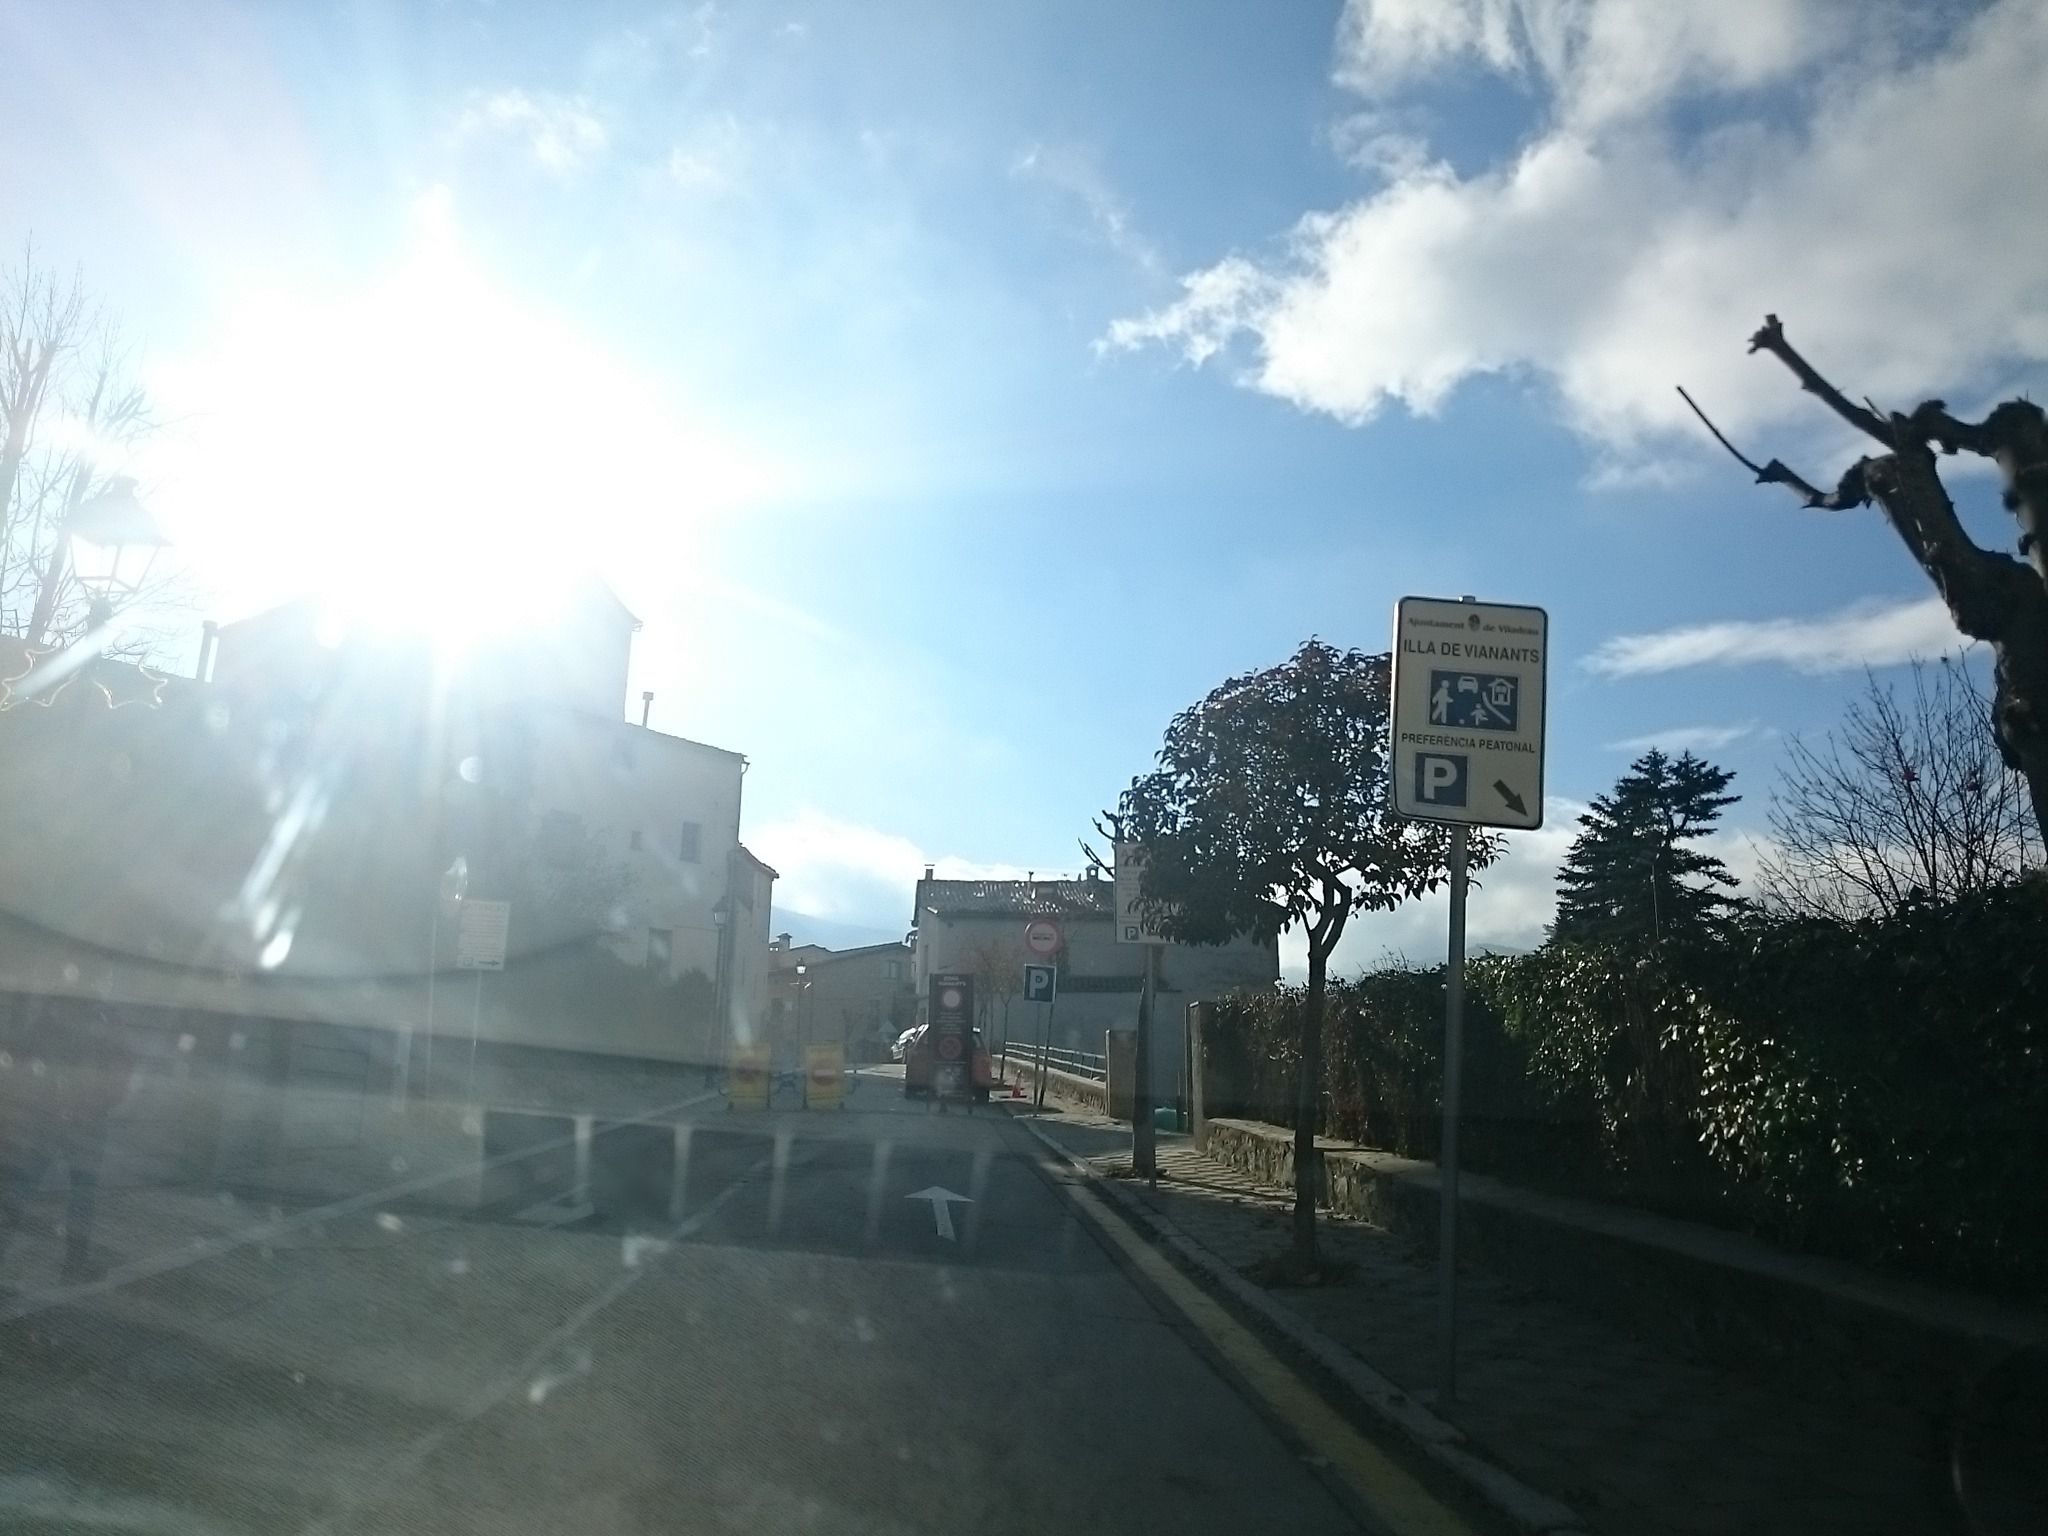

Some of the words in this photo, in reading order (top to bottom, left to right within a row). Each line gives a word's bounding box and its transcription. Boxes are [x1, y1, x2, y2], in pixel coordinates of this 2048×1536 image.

[1482, 624, 1496, 632] de
[1403, 639, 1436, 655] ILLA
[1440, 641, 1461, 657] DE
[1464, 643, 1540, 663] VIANANTS
[1478, 739, 1536, 753] PEATONAL
[1424, 758, 1457, 799] P
[1029, 969, 1049, 999] P
